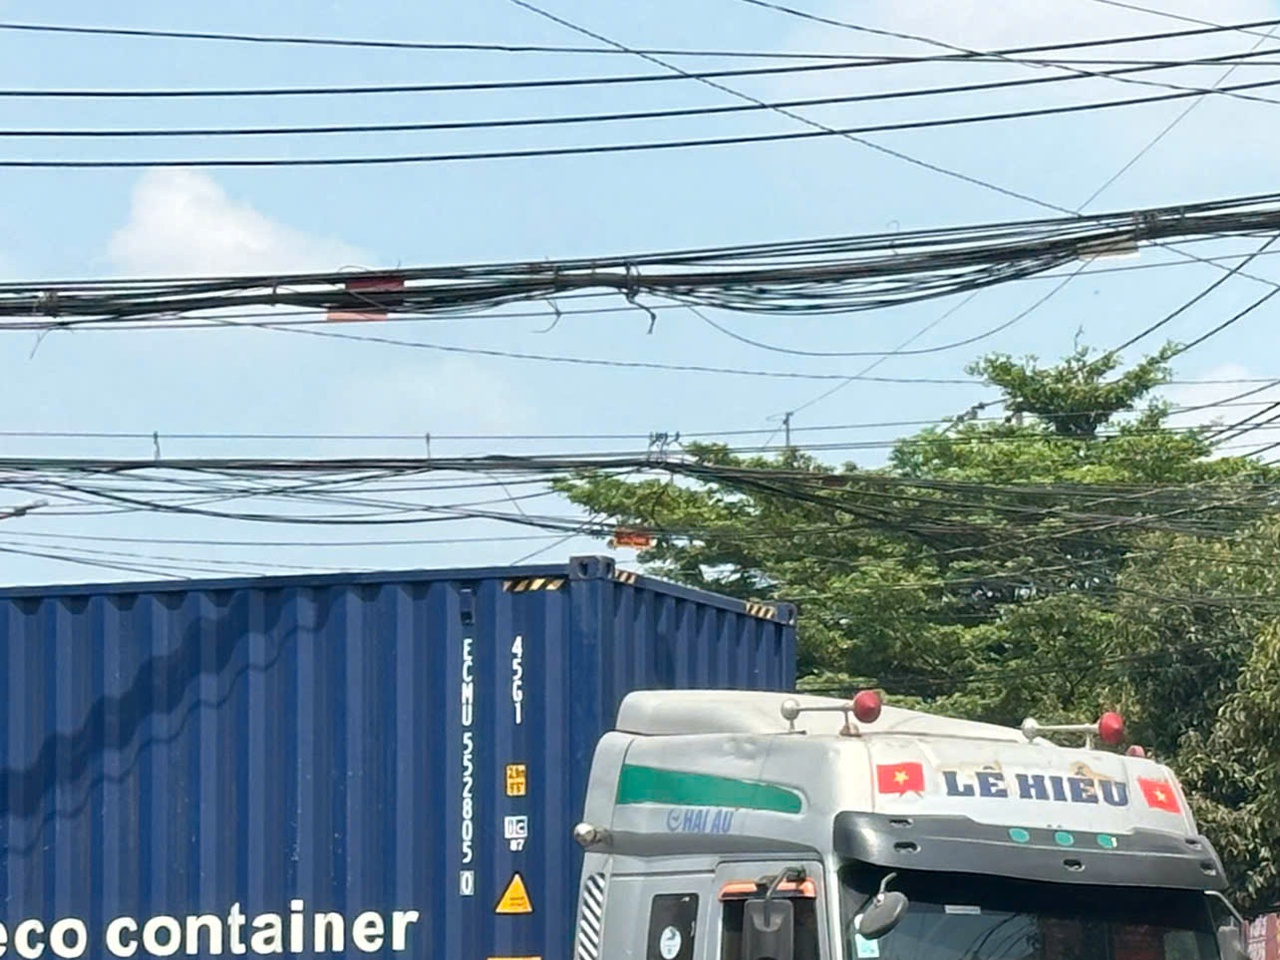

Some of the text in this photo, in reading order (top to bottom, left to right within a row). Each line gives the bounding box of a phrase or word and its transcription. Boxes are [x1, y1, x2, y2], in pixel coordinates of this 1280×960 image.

[942, 765, 1008, 799] LÊ
[0, 899, 420, 960] co container
